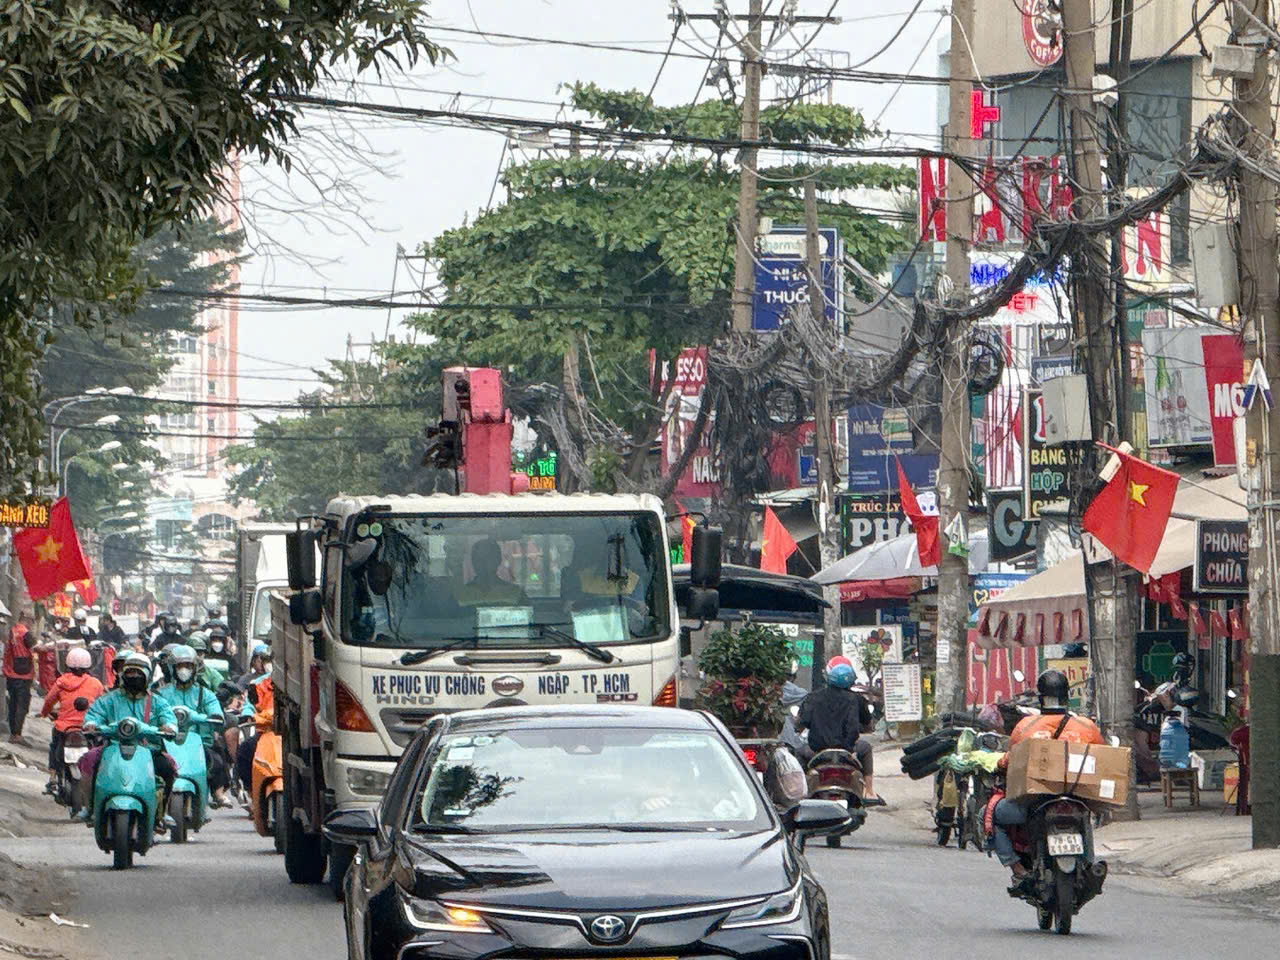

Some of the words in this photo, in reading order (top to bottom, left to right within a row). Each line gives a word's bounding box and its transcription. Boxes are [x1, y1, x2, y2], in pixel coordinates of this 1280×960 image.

[1031, 443, 1066, 465] BẢNG
[1031, 468, 1064, 494] HỘP
[851, 499, 883, 513] TRÚC
[1203, 528, 1248, 552] PHÒNG
[1206, 558, 1243, 583] CHỮA
[372, 675, 386, 695] XE
[389, 674, 421, 699] PHỤC
[425, 675, 441, 698] VỤ
[538, 673, 569, 699] NGẬP
